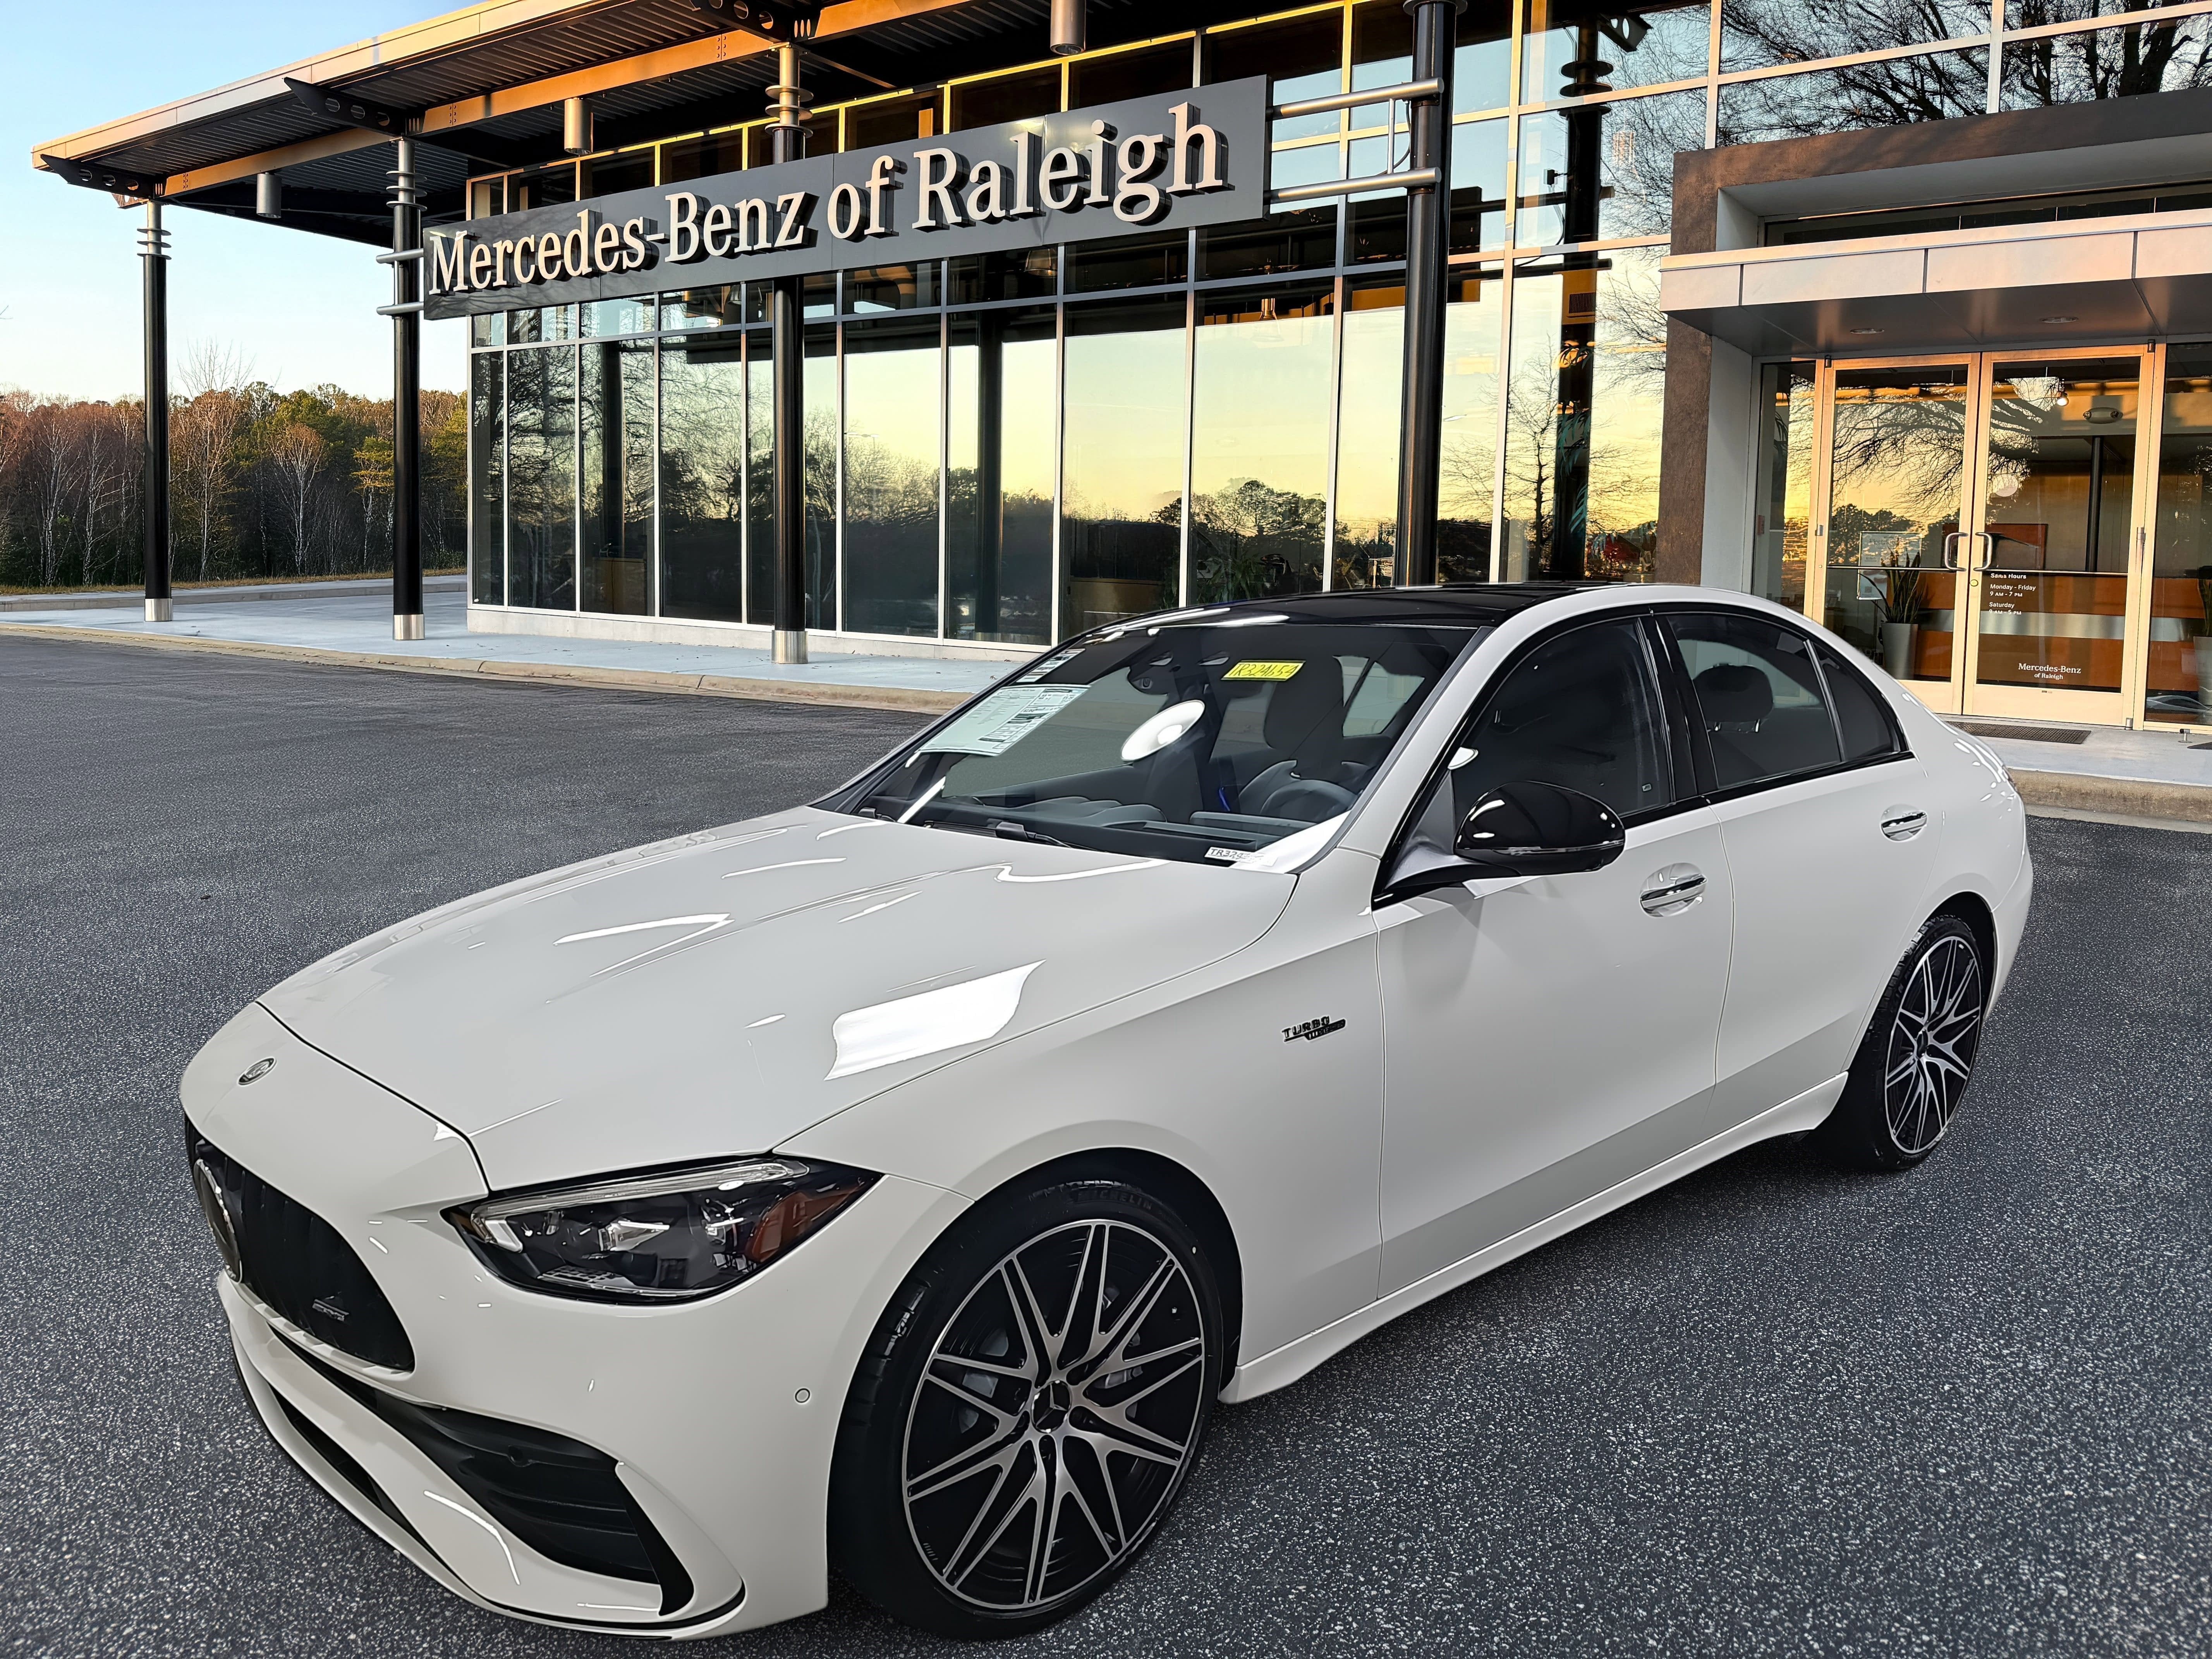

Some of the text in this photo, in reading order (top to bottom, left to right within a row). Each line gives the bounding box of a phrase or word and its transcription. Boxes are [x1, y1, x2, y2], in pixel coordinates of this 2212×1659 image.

[428, 101, 1223, 295] Mercedes-Benz of Raleigh
[2018, 663, 2081, 674] Mercedes-Benz
[1281, 1015, 1330, 1039] TURBO
